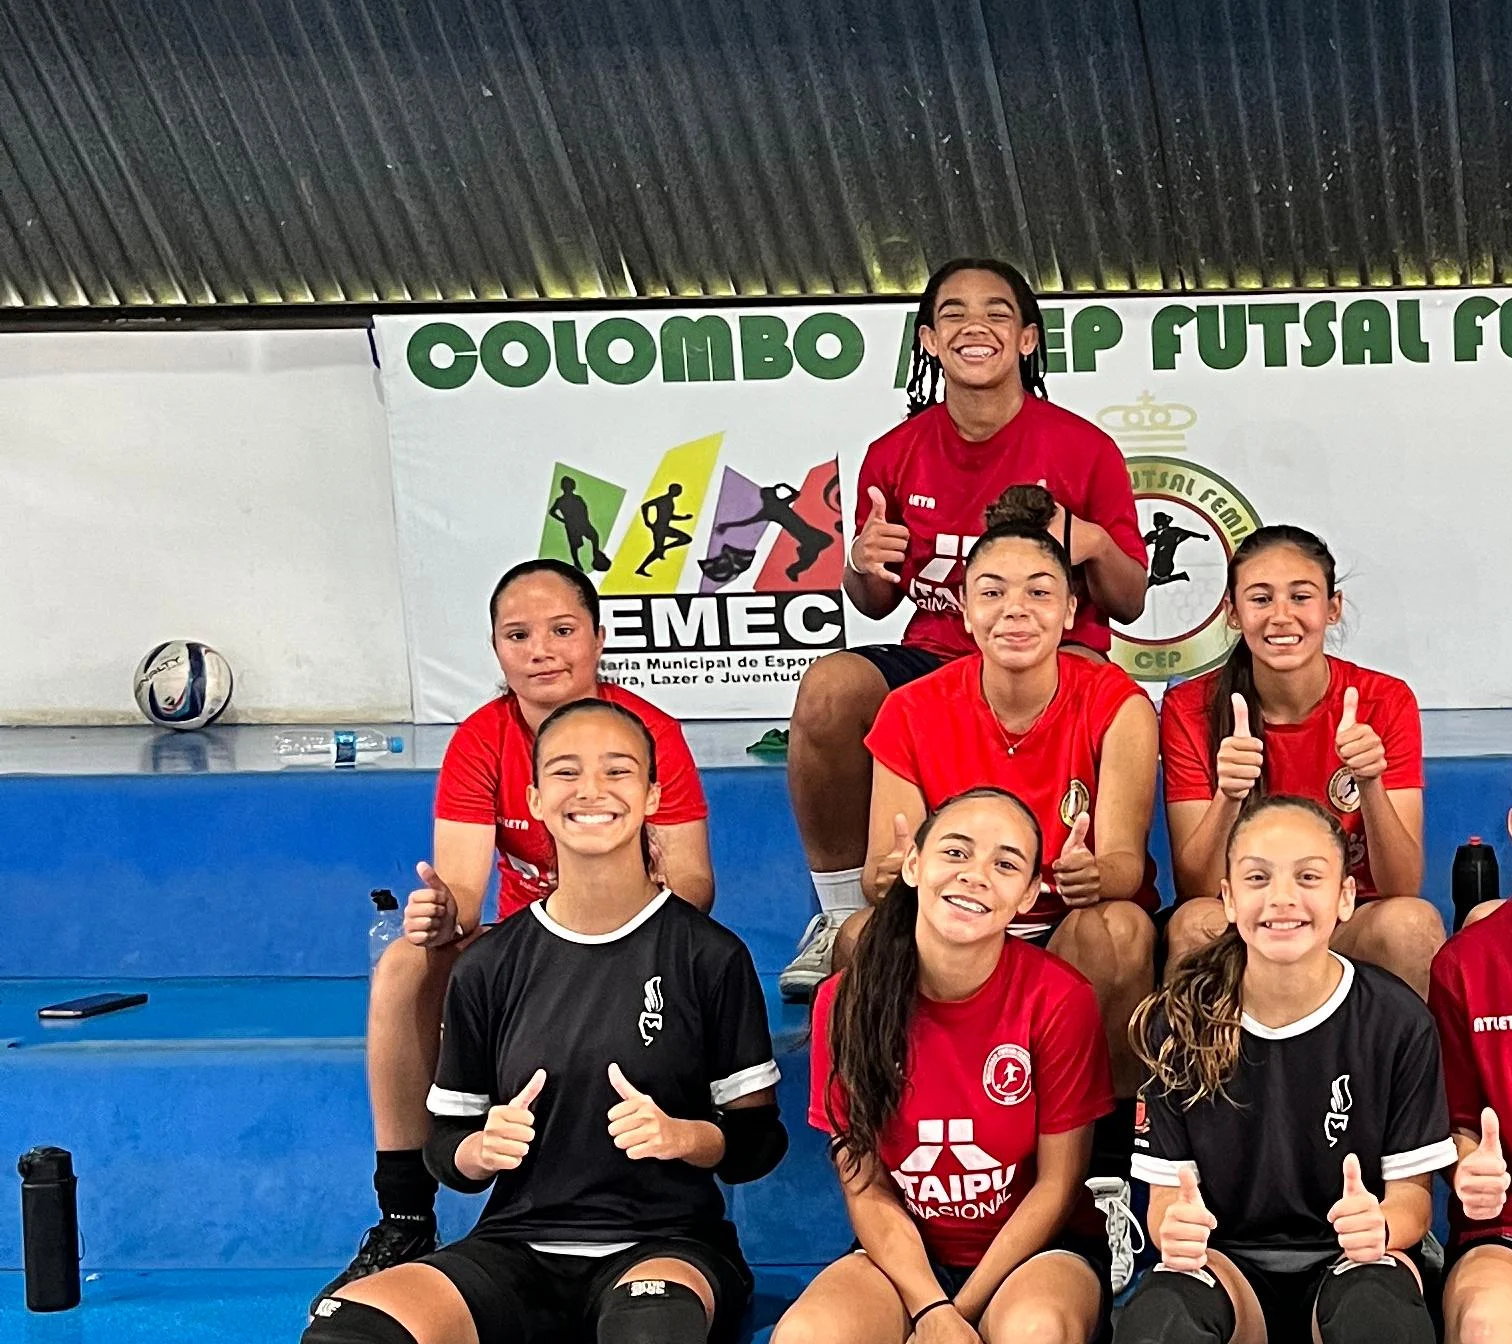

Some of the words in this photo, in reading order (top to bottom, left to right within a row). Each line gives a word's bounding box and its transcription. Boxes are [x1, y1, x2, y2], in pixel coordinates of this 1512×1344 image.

[406, 312, 865, 390] COLOMBO
[1038, 305, 1123, 374] EP
[1151, 300, 1430, 370] FUTSAL
[1132, 470, 1196, 496] UTSAL
[599, 593, 842, 648] EMEC
[646, 656, 731, 670] Municipal
[737, 655, 758, 668] de
[1134, 650, 1182, 670] CEP
[651, 673, 697, 685] Lazer
[704, 674, 714, 684] e
[721, 670, 801, 683] Juventud
